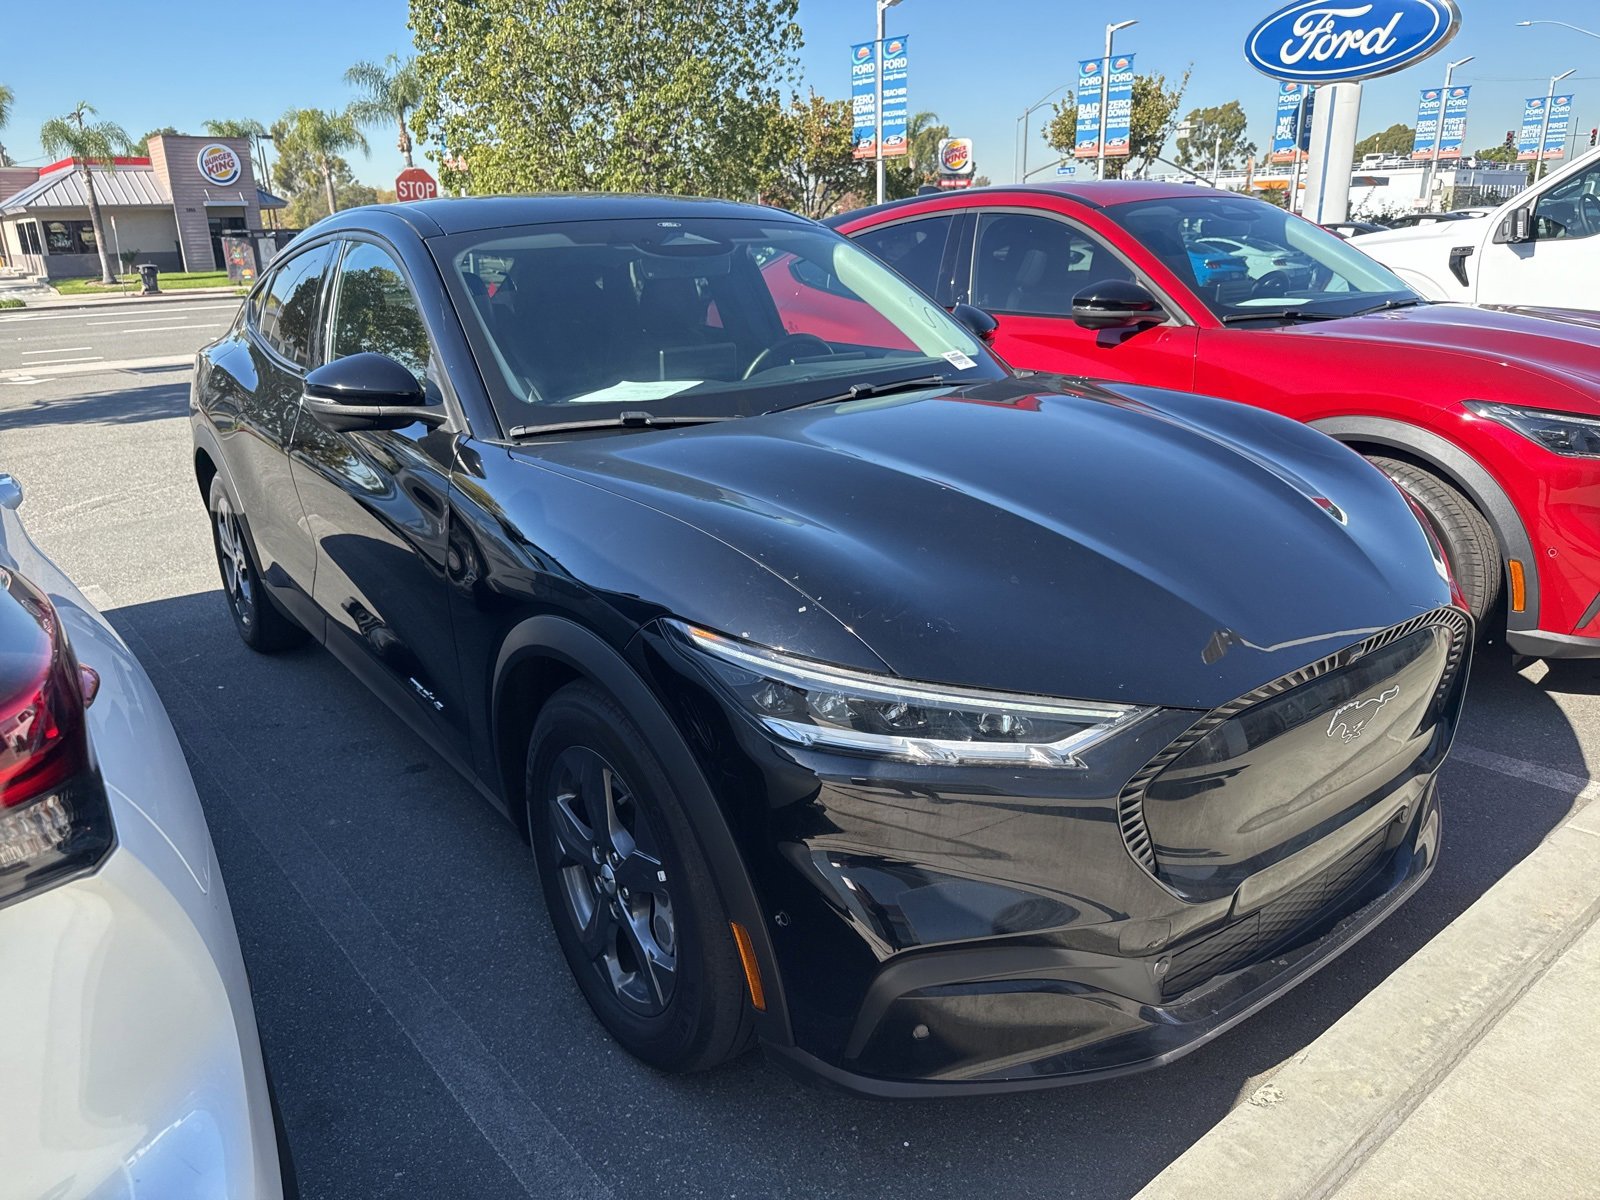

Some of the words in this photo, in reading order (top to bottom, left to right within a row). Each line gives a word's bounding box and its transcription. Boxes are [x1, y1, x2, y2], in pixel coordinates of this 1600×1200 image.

[1280, 4, 1404, 65] Ford
[883, 57, 907, 70] FORD
[853, 63, 875, 75] FORD
[1079, 76, 1101, 86] FORD
[1110, 73, 1133, 82] FORD
[853, 94, 875, 105] ZERO
[1279, 94, 1300, 103] FORD
[853, 104, 875, 114] DOWN
[1078, 103, 1100, 113] BAD
[1108, 99, 1131, 109] ZERO
[1420, 101, 1440, 109] FORD
[1108, 108, 1131, 117] DOWN
[1280, 116, 1295, 125] WE
[1277, 125, 1296, 134] BUY
[204, 152, 232, 167] BURGER
[945, 151, 968, 165] KING
[207, 159, 235, 175] KING
[399, 181, 435, 199] STOP
